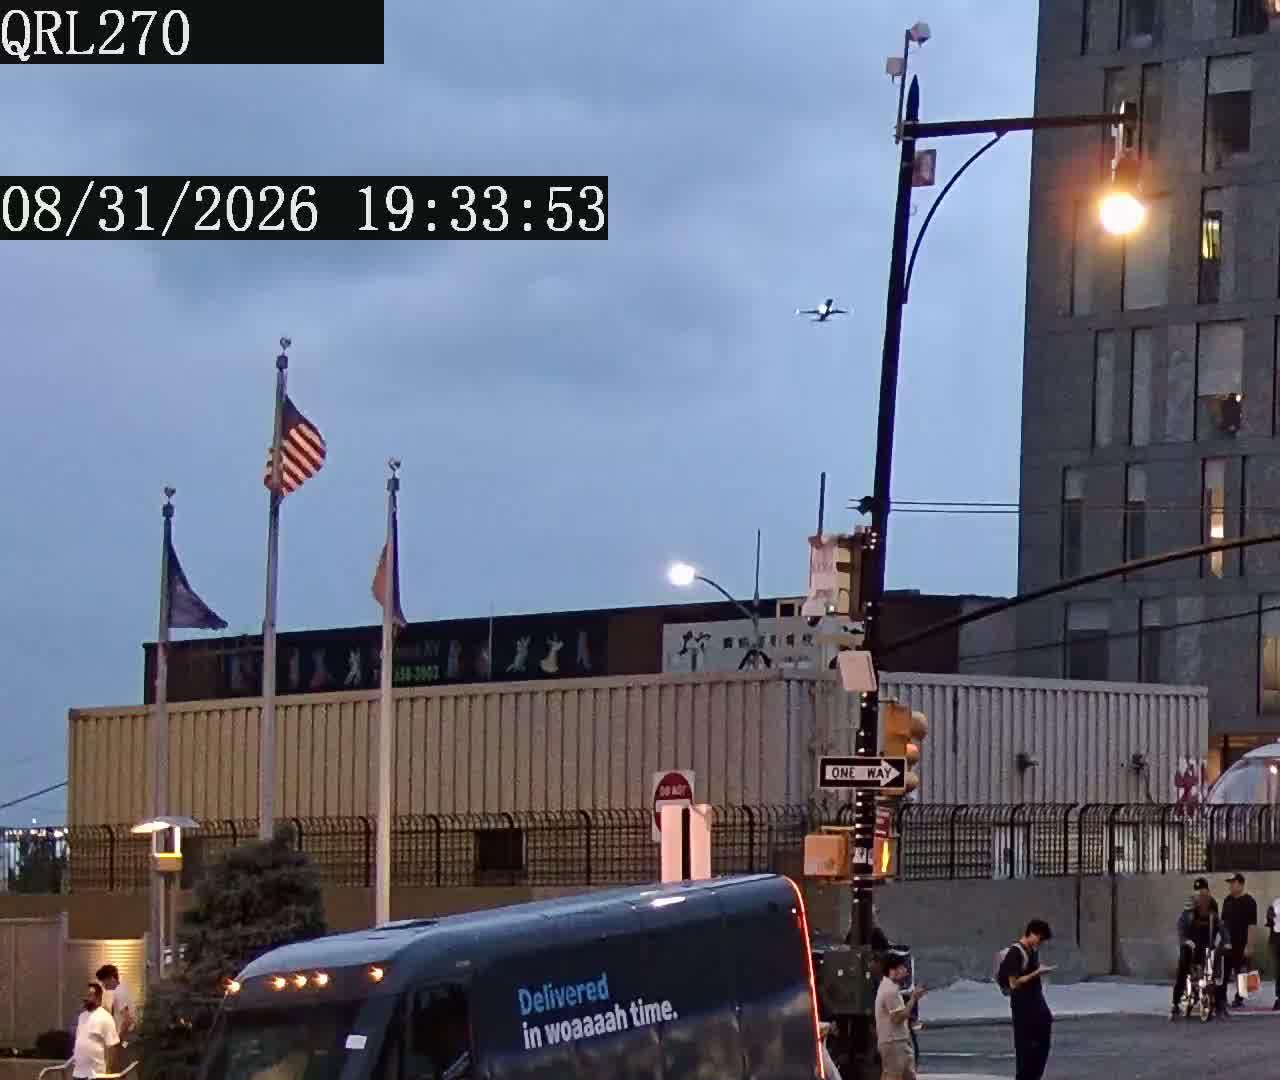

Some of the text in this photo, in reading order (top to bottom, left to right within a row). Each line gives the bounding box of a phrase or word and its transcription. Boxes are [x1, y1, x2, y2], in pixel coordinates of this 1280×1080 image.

[831, 766, 893, 779] ONE WAY
[517, 971, 610, 1016] Delivered
[522, 997, 679, 1050] in woaaaah time.
